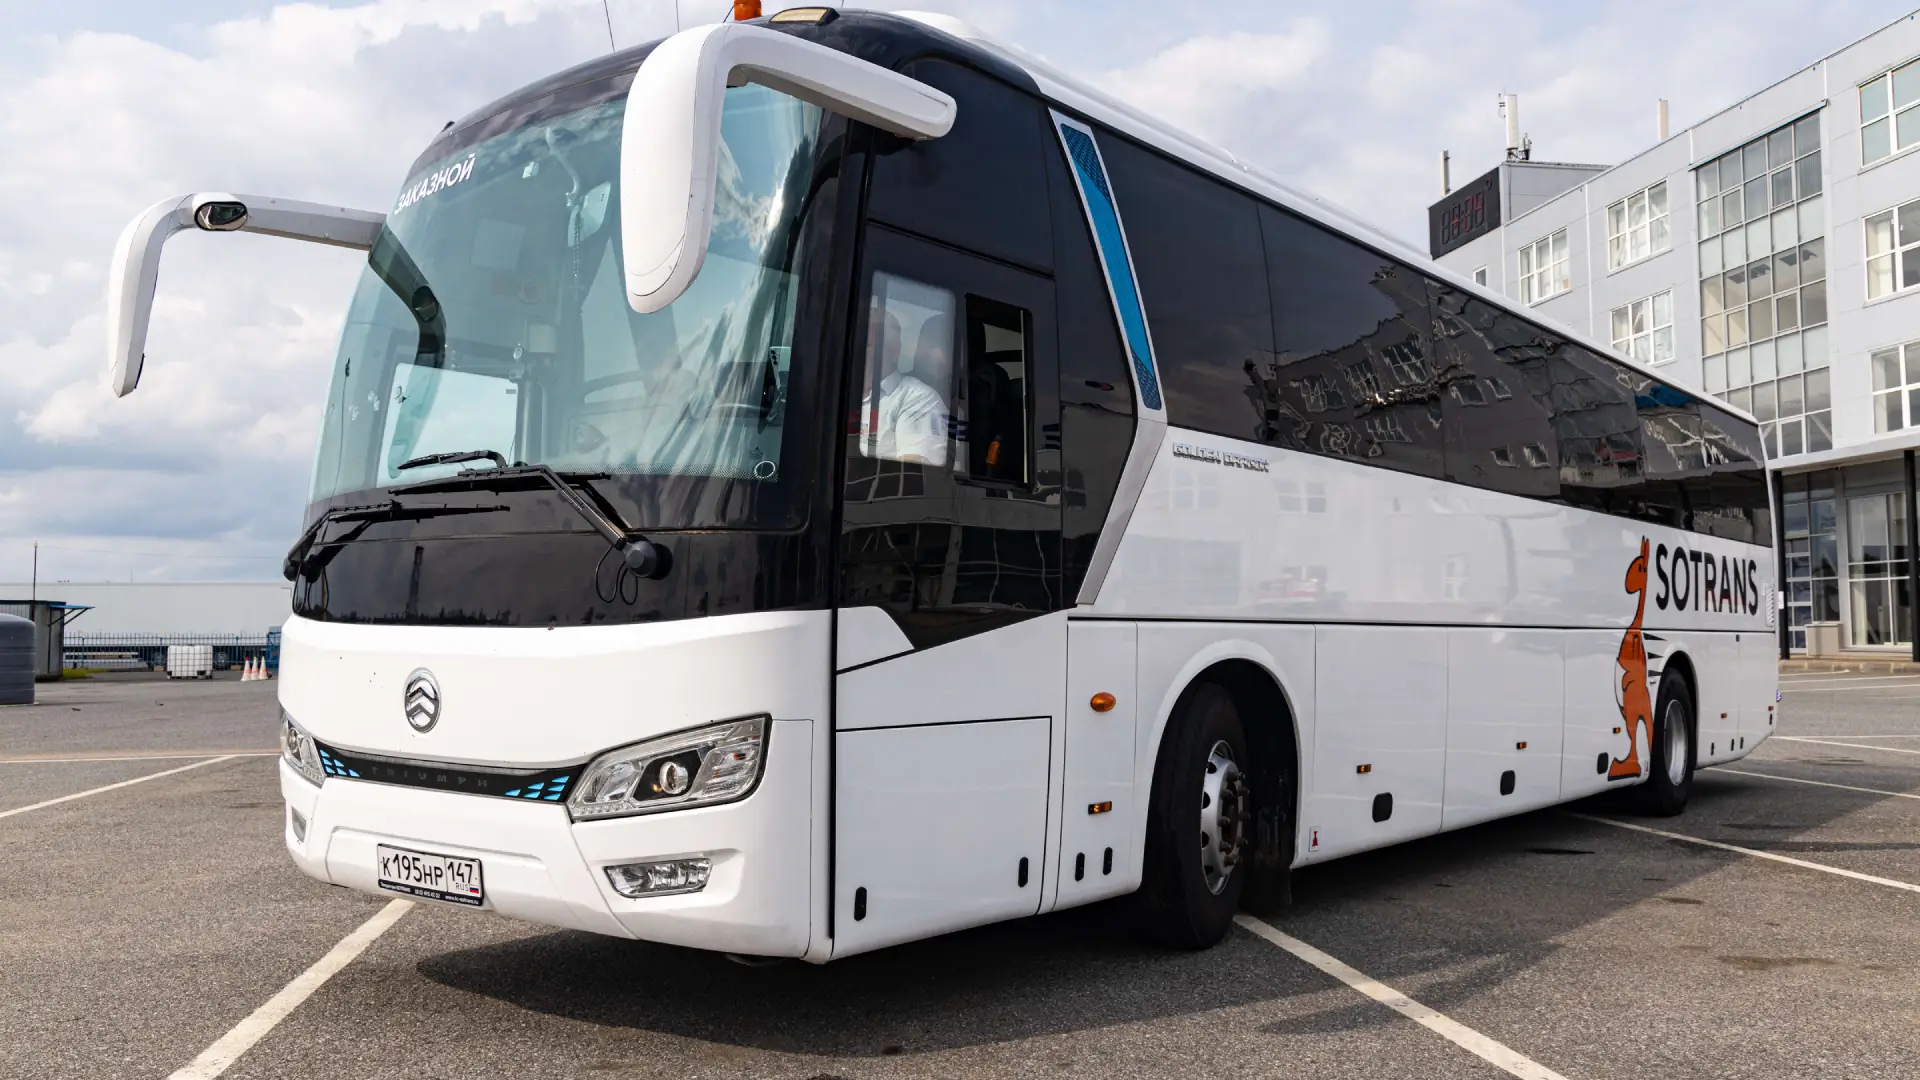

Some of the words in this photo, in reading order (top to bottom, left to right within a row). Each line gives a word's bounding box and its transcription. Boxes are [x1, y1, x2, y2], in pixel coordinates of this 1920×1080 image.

[393, 152, 476, 215] ЗАКАЗНОЙ
[1655, 543, 1758, 616] SOTRANS
[372, 767, 488, 788] TRIUMPH
[447, 861, 473, 884] 147
[455, 882, 469, 892] RUS
